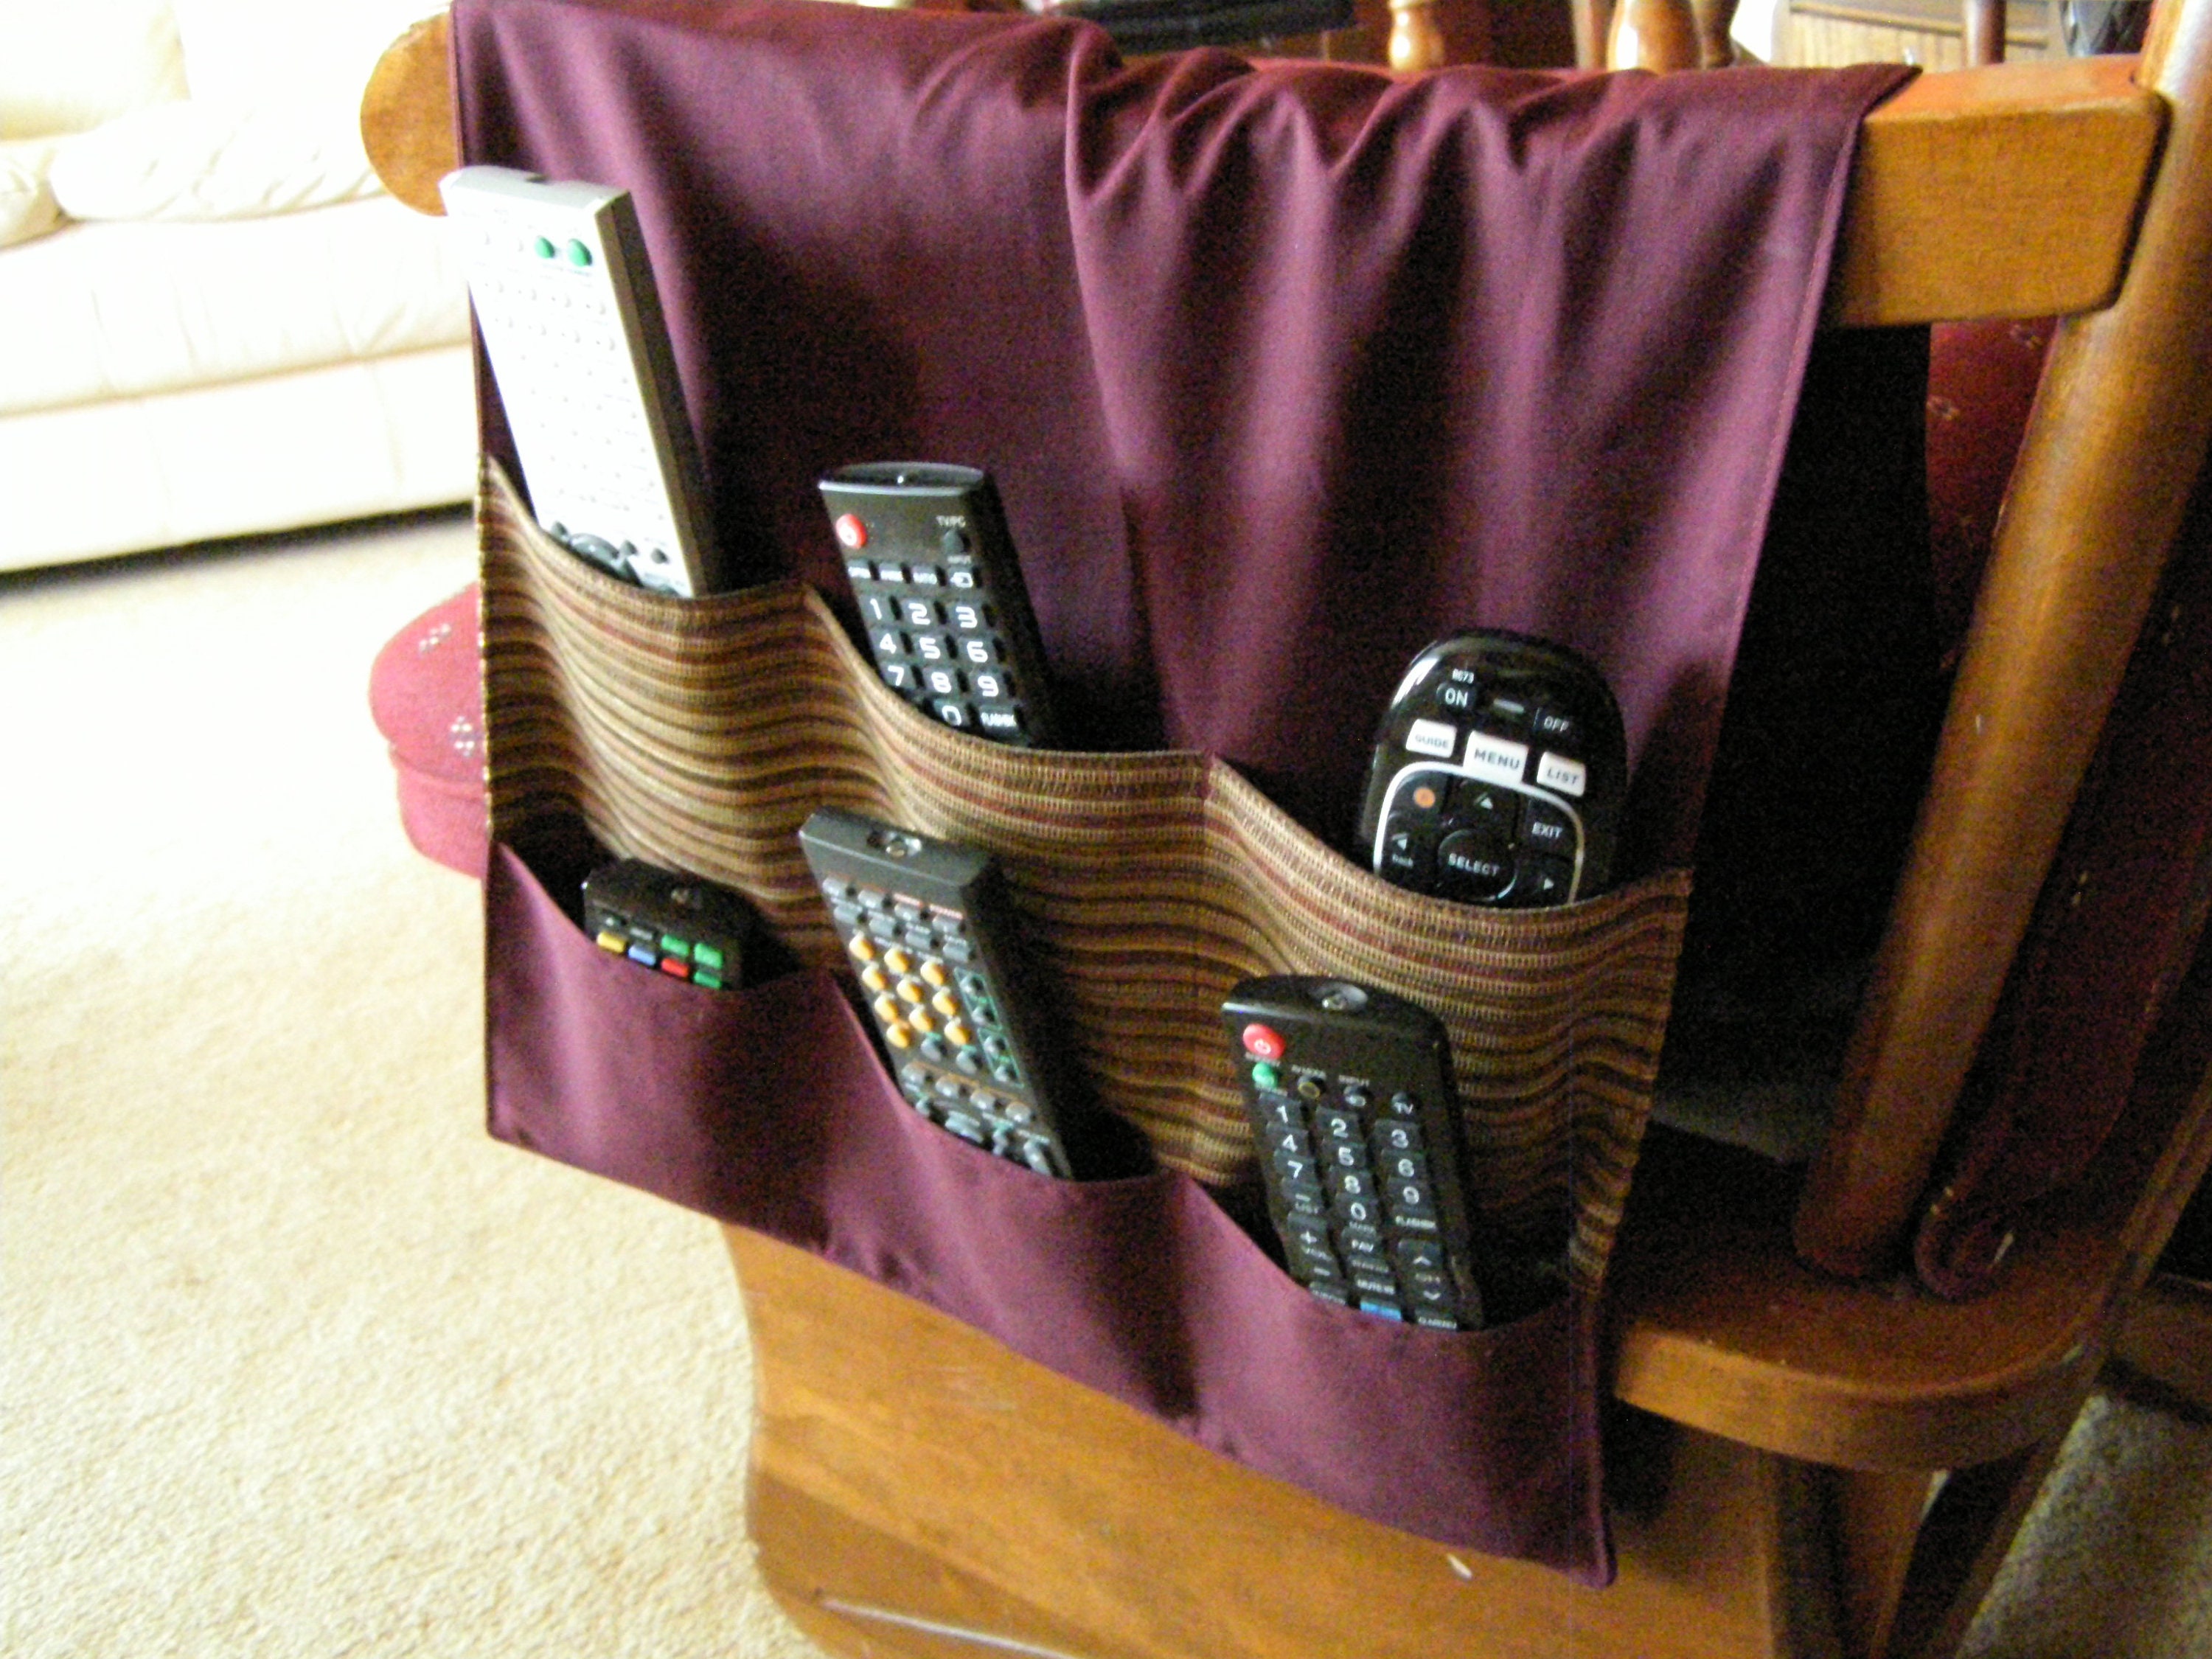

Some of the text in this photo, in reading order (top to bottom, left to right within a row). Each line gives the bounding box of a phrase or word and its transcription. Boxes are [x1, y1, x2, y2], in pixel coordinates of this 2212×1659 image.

[869, 598, 978, 629] 1 2 3
[879, 633, 988, 663] 4 5 6
[887, 665, 999, 697] 7 8 9
[1444, 687, 1469, 709] ON
[941, 704, 962, 726] 0
[1543, 715, 1570, 733] OFF
[1414, 733, 1450, 749] GUIDE
[1474, 748, 1521, 771] MENU
[1546, 765, 1580, 785] LIST
[1531, 821, 1563, 840] EXIT
[1447, 852, 1501, 877] SELECT
[1276, 1105, 1409, 1150] 1 2 3
[1281, 1133, 1415, 1178] 4 5 6
[1287, 1160, 1304, 1179] 7
[1344, 1175, 1361, 1195] 8
[1350, 1202, 1367, 1221] 0
